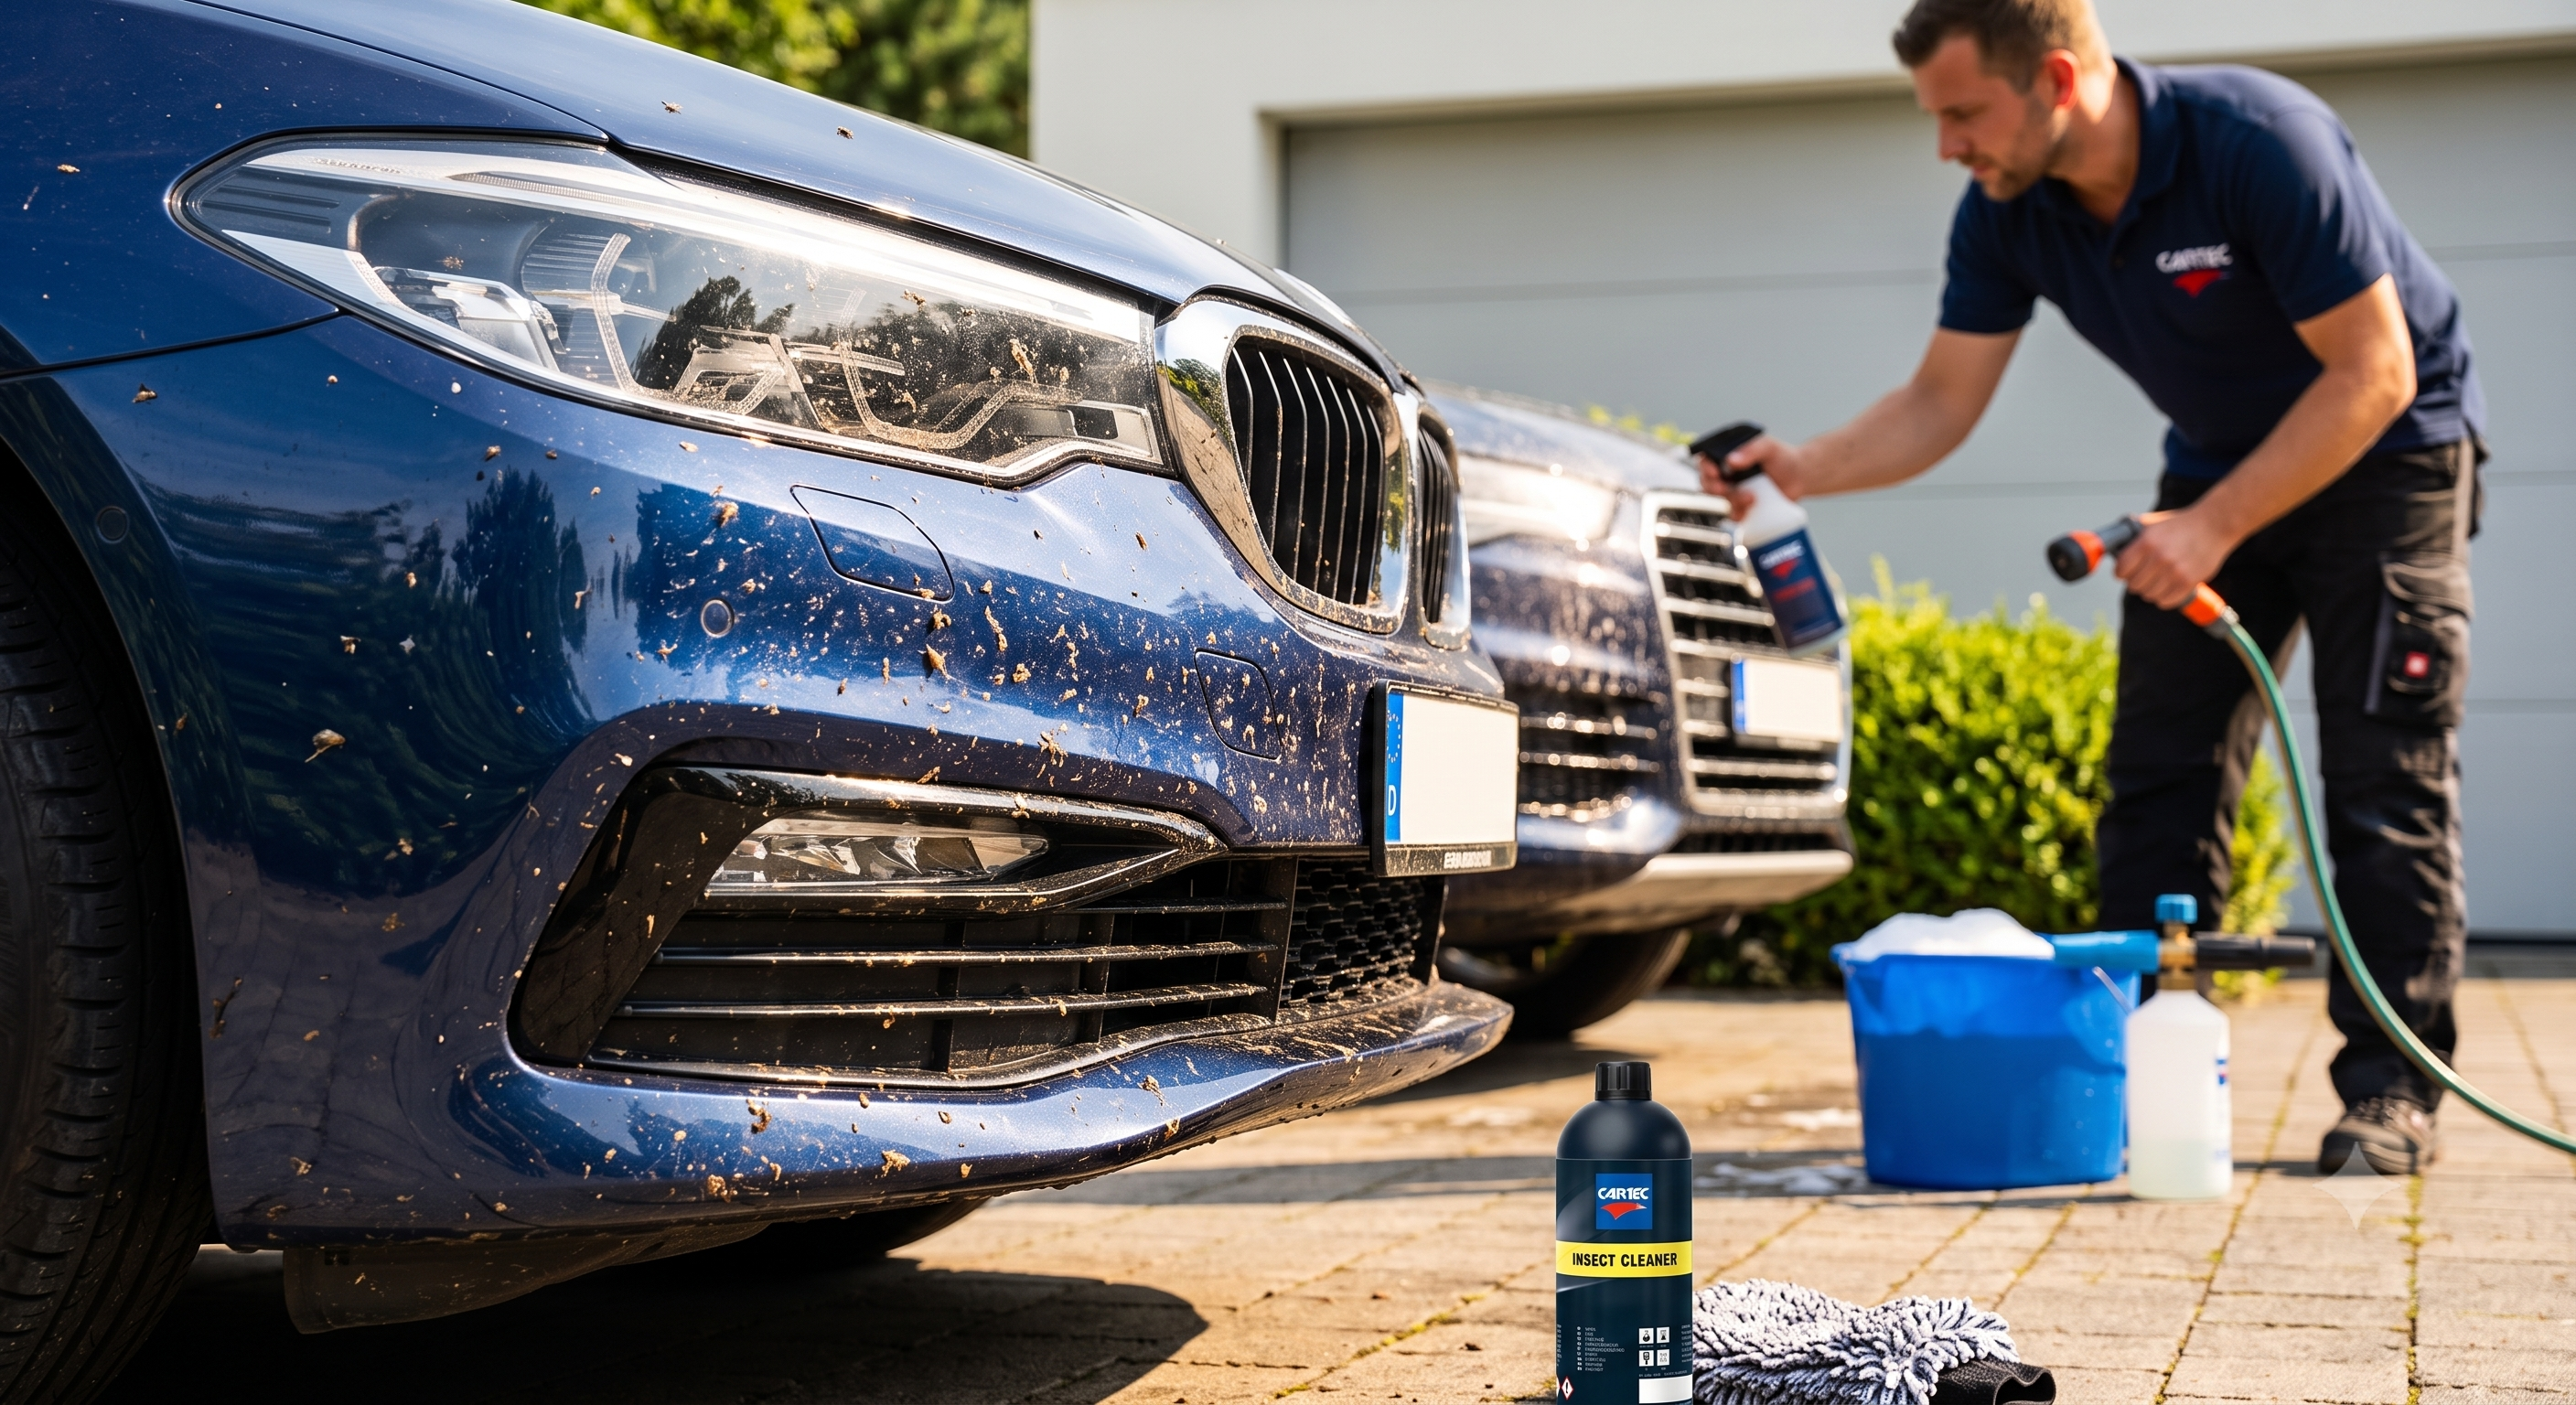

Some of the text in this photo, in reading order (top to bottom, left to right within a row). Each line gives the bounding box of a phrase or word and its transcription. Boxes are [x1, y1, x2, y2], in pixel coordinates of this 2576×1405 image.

[1388, 785, 1397, 816] D
[1597, 1187, 1649, 1200] CARTEC
[1572, 1252, 1678, 1267] INSECT CLEANER
